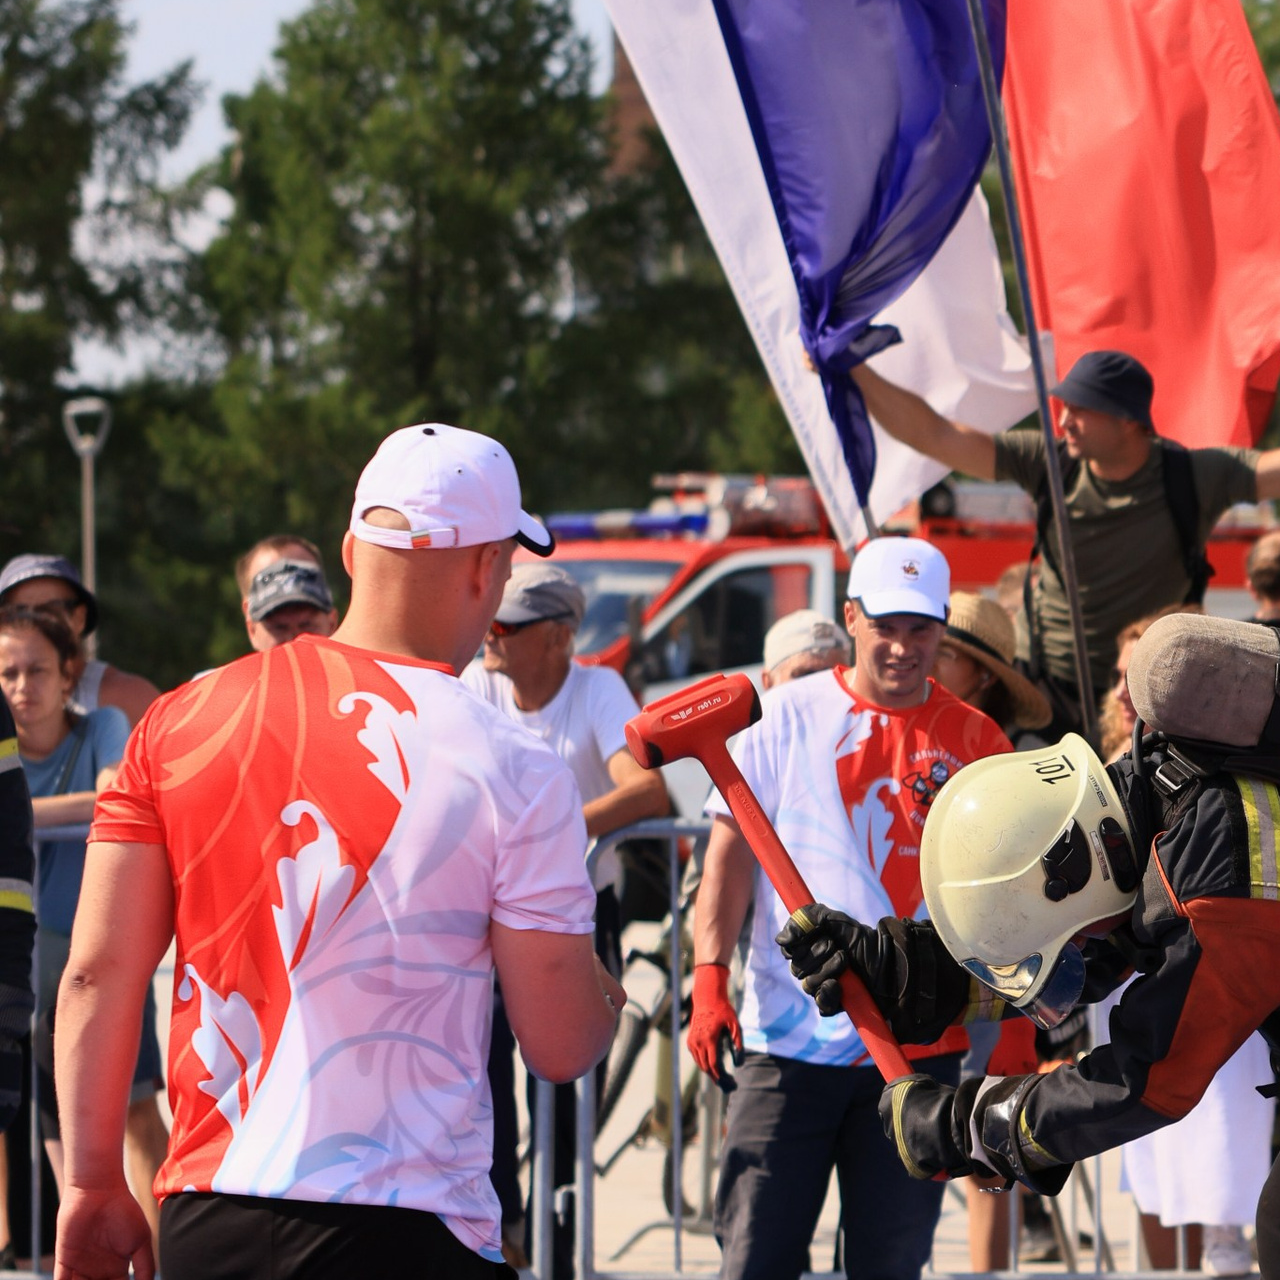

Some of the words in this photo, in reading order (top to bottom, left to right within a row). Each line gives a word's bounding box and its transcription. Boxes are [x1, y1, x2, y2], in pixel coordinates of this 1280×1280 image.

[909, 749, 966, 770] СИЛЬНЕЙШИ
[1029, 757, 1072, 785] 101
[898, 846, 918, 856] САНК
